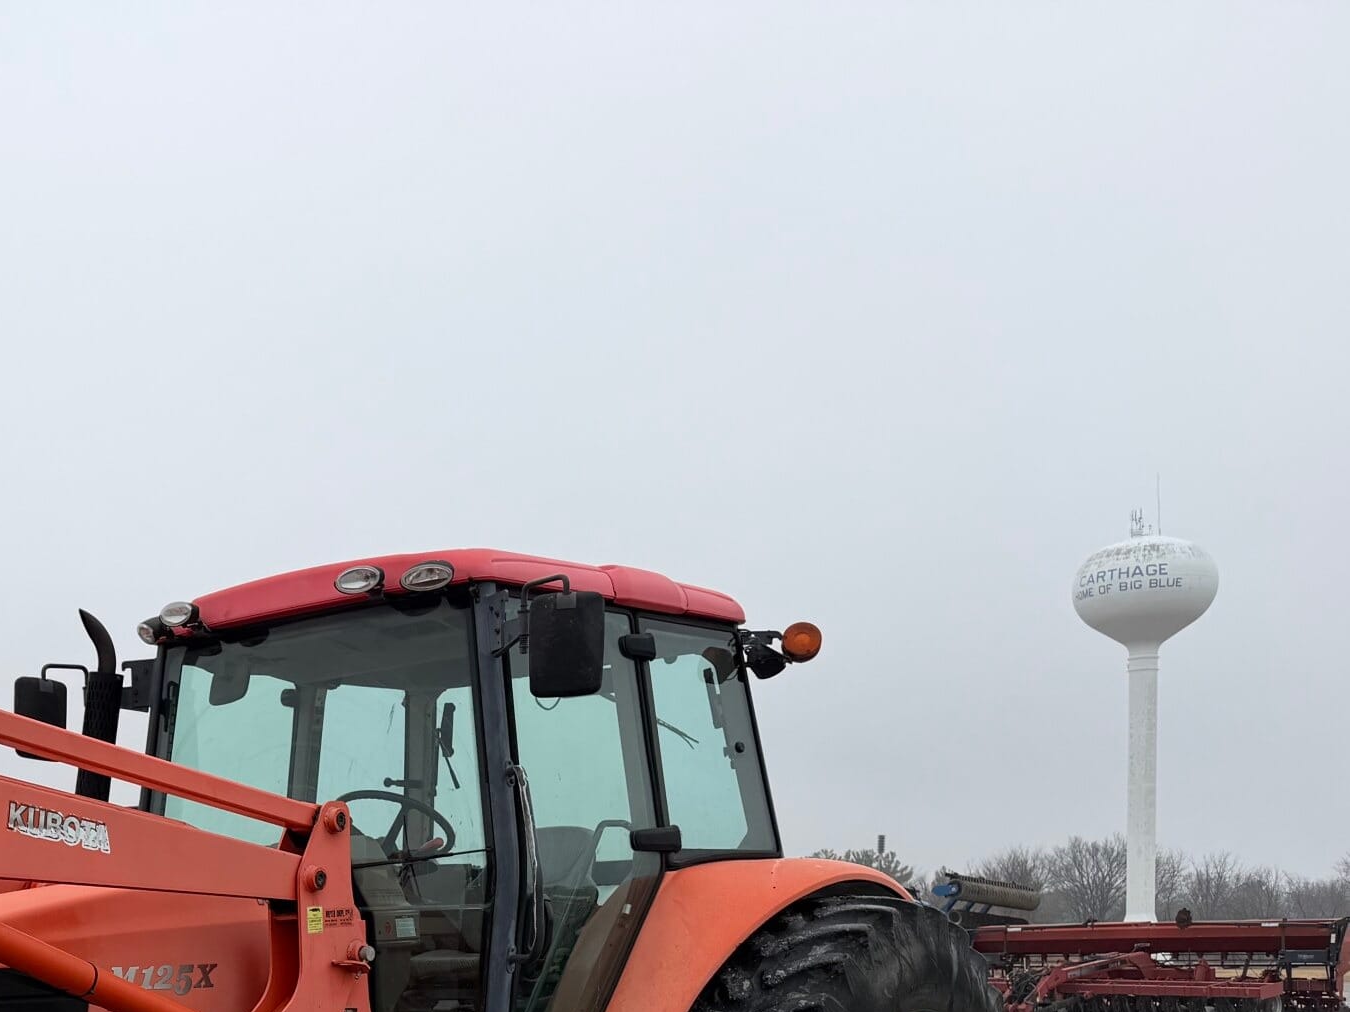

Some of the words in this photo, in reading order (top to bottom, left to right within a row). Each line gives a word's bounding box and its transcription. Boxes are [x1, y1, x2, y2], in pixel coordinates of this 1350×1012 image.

[1079, 563, 1168, 587] CARTHAGE
[1098, 583, 1113, 595] OF
[1119, 579, 1143, 592] BIG
[1149, 577, 1183, 589] BLUE
[8, 800, 110, 853] KUBOTA
[111, 963, 218, 995] M125X
